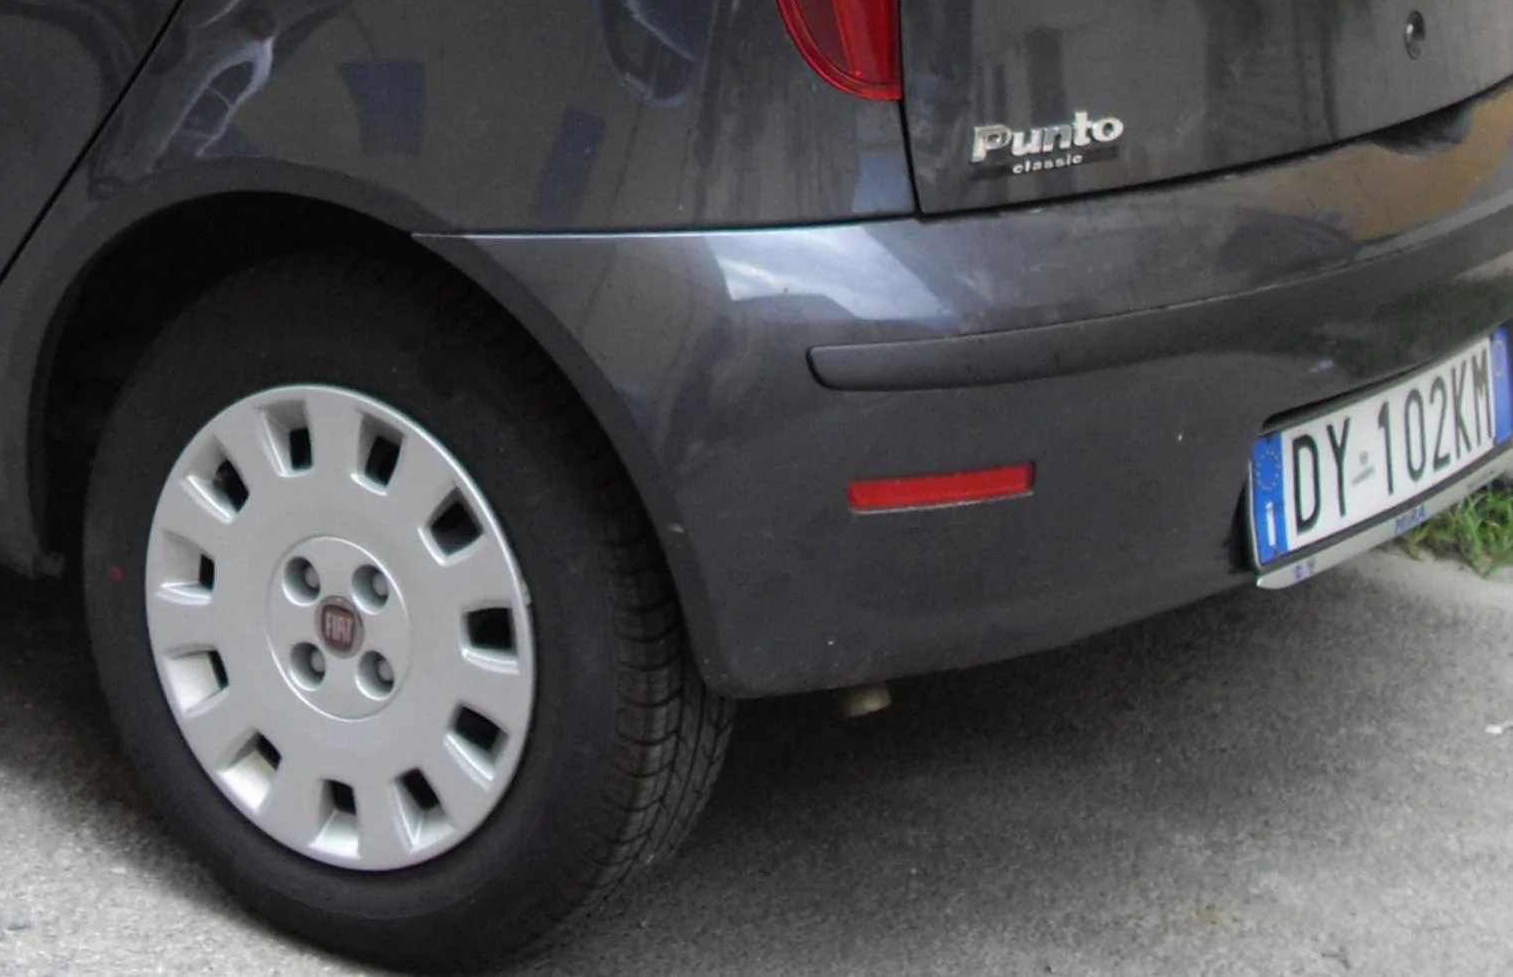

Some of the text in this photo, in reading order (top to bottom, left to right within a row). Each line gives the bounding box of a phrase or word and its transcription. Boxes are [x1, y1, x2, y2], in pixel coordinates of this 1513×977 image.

[971, 109, 1125, 163] Punto
[1012, 153, 1083, 175] classic
[326, 612, 354, 644] FIAT
